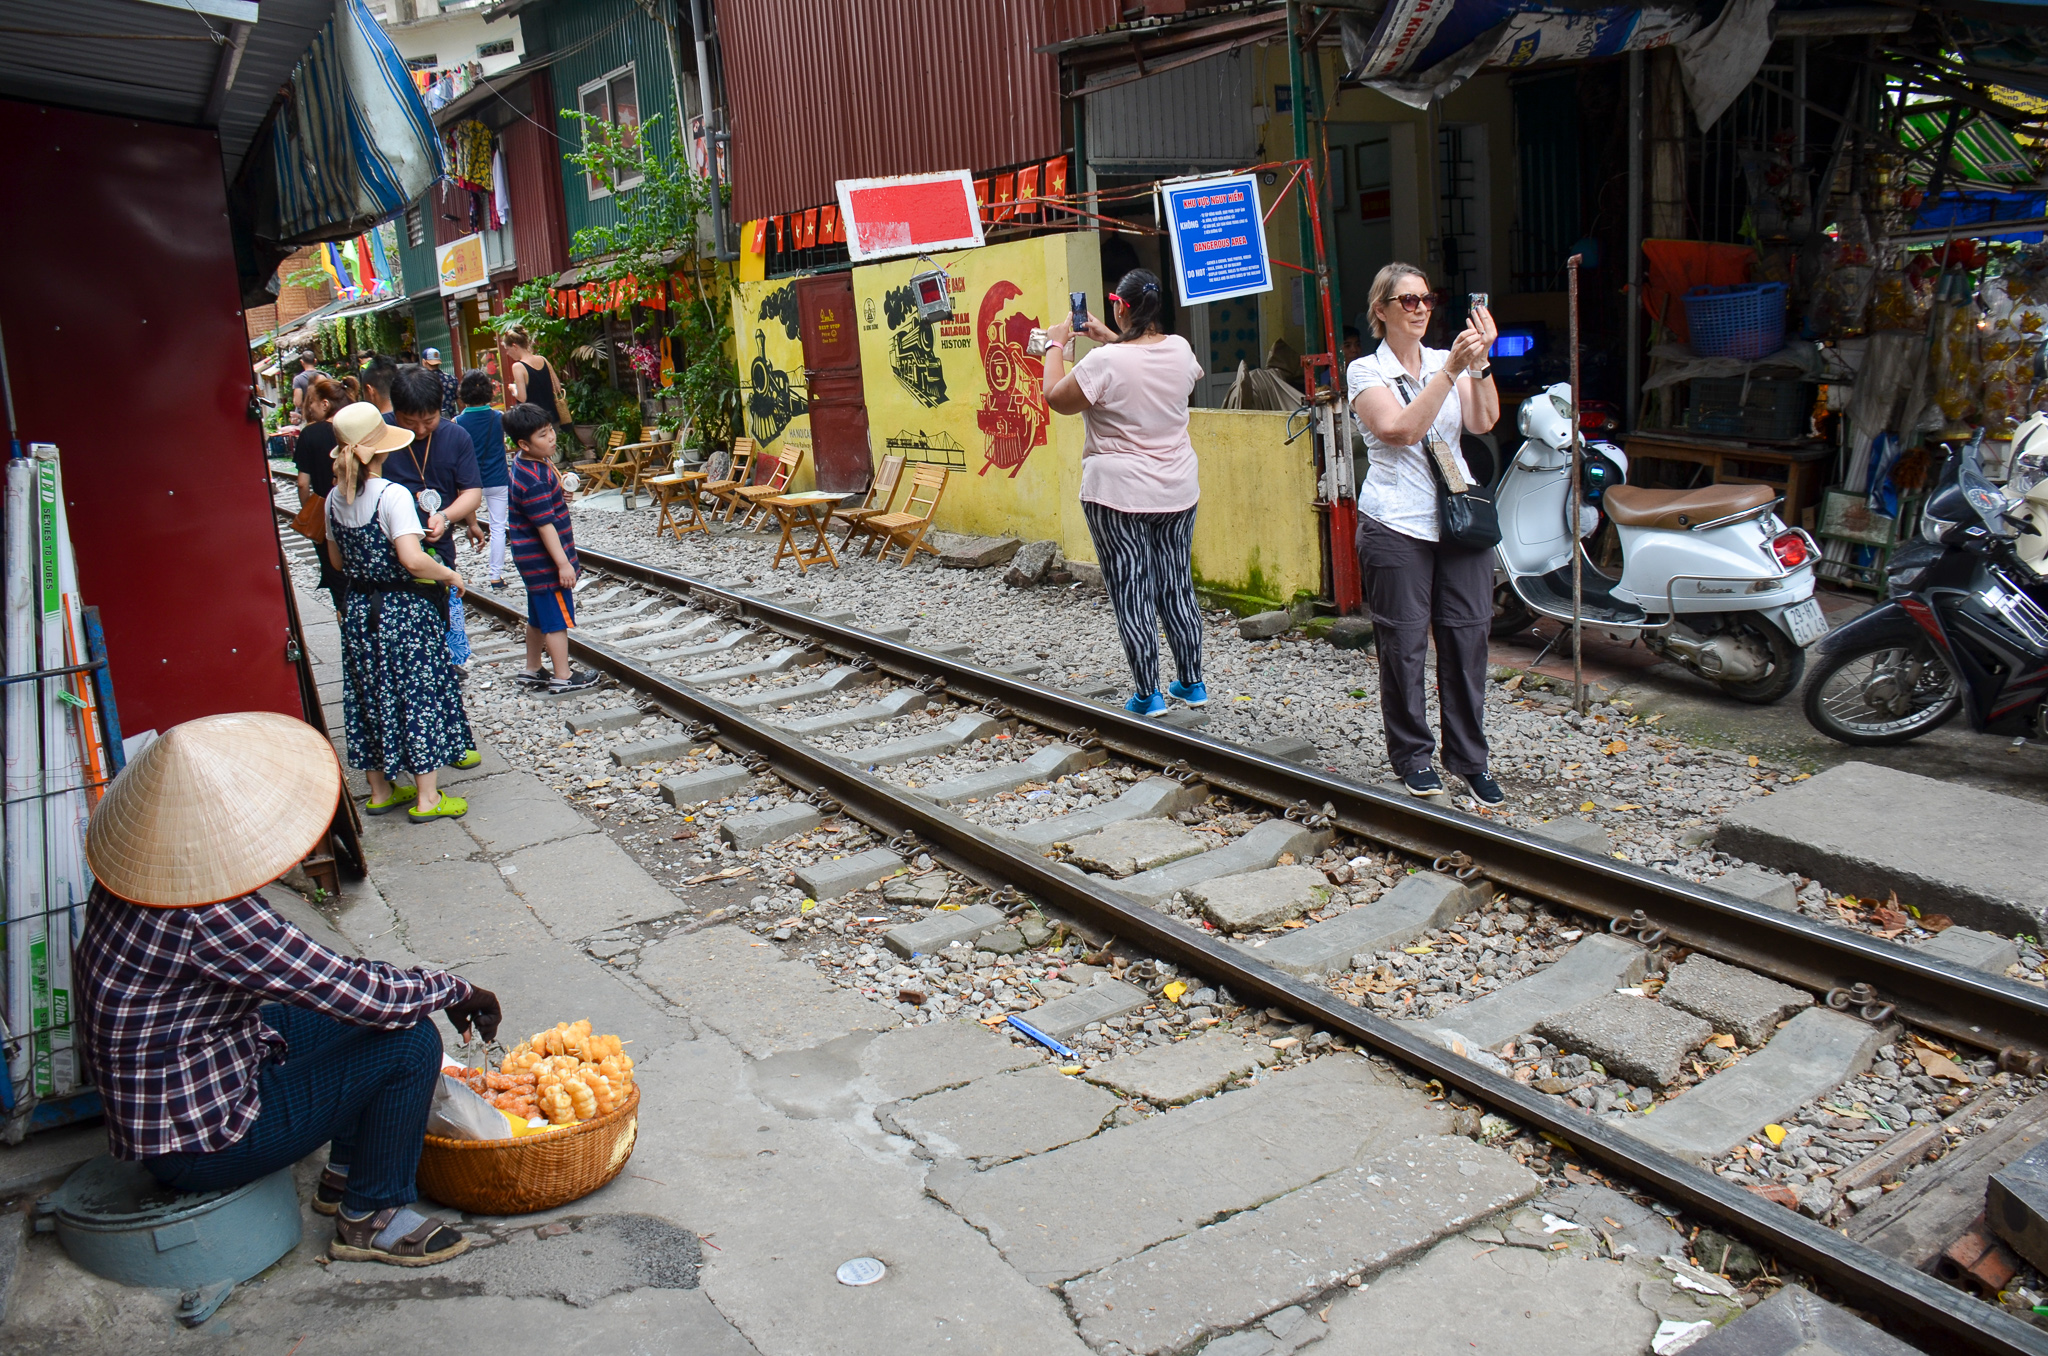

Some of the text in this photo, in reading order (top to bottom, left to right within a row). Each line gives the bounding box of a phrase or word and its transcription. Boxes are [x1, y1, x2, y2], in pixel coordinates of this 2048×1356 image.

[1183, 198, 1197, 209] KHU
[1211, 194, 1227, 206] NGUY
[1180, 220, 1199, 230] KHÔNG
[1193, 235, 1247, 252] DANGEROUS AREA
[1187, 270, 1195, 278] DO
[1195, 268, 1206, 277] NOT
[940, 326, 971, 337] RAILROAD
[941, 338, 971, 349] HISTORY
[41, 467, 54, 503] LED
[43, 508, 51, 541] SERIES
[45, 559, 53, 590] TUBES
[1697, 581, 1736, 594] Vespa
[1790, 601, 1818, 625] 29-H1
